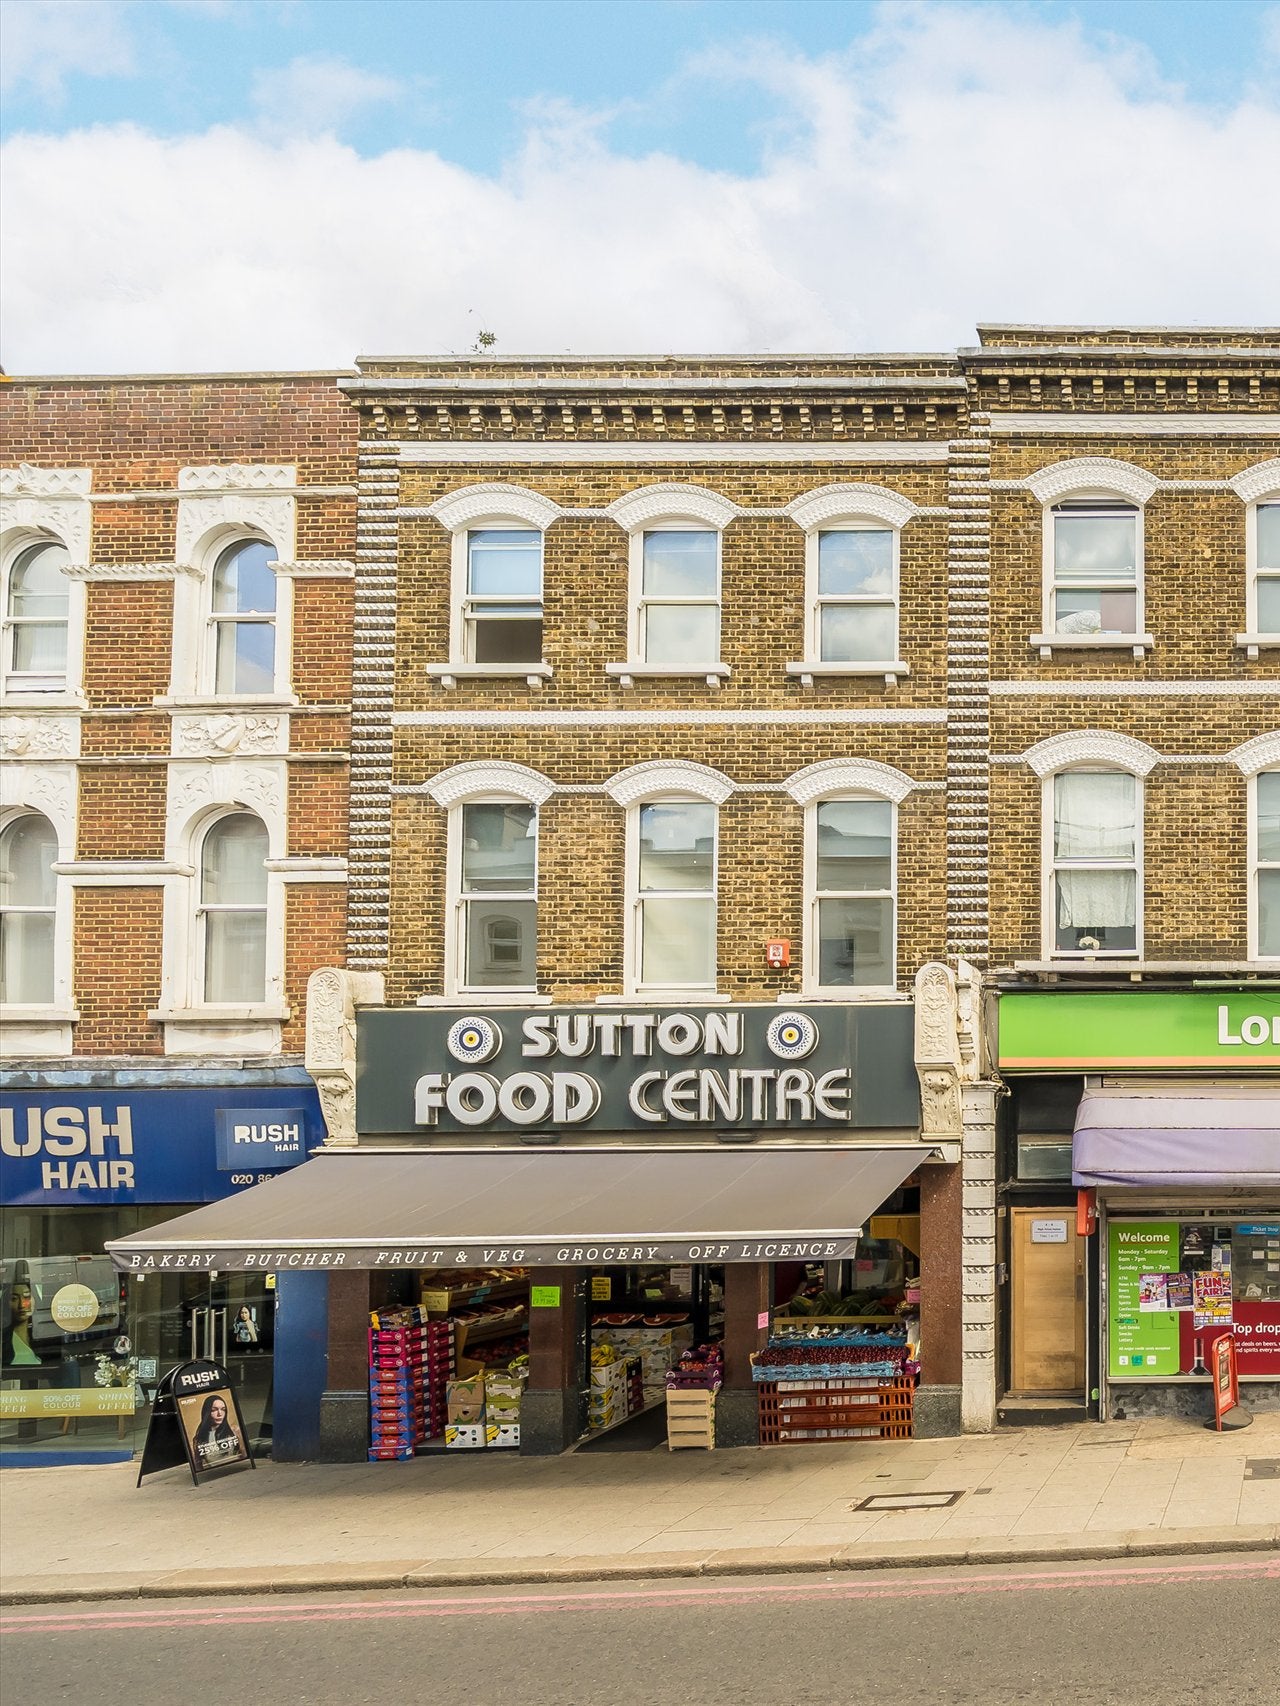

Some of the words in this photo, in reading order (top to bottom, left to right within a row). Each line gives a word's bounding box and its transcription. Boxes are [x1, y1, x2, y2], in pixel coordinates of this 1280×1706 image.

[521, 1013, 744, 1057] SUTTON
[414, 1070, 602, 1125] FOOD
[629, 1068, 851, 1122] CENTRE
[234, 1124, 299, 1143] RUSH
[275, 1144, 299, 1152] HAIR
[42, 1161, 135, 1189] HAIR
[231, 1174, 253, 1184] 020
[1118, 1232, 1170, 1242] Welcome
[129, 1254, 217, 1267] BAKERY
[244, 1253, 346, 1266] BUTCHER
[374, 1251, 443, 1264] FRUIT
[455, 1251, 467, 1263] &
[482, 1250, 525, 1262] VEG
[556, 1247, 659, 1261] GROCERY
[688, 1245, 730, 1259] OFF
[741, 1243, 838, 1257] LICENCE
[1195, 1277, 1222, 1288] FUN
[1197, 1287, 1223, 1296] FAIR!
[1232, 1323, 1252, 1336] Top
[181, 1370, 220, 1386] RUSH
[43, 1395, 63, 1403] 50%
[43, 1401, 81, 1409] COLOUR
[199, 1445, 220, 1456] 25%
[221, 1438, 239, 1449] OFF
